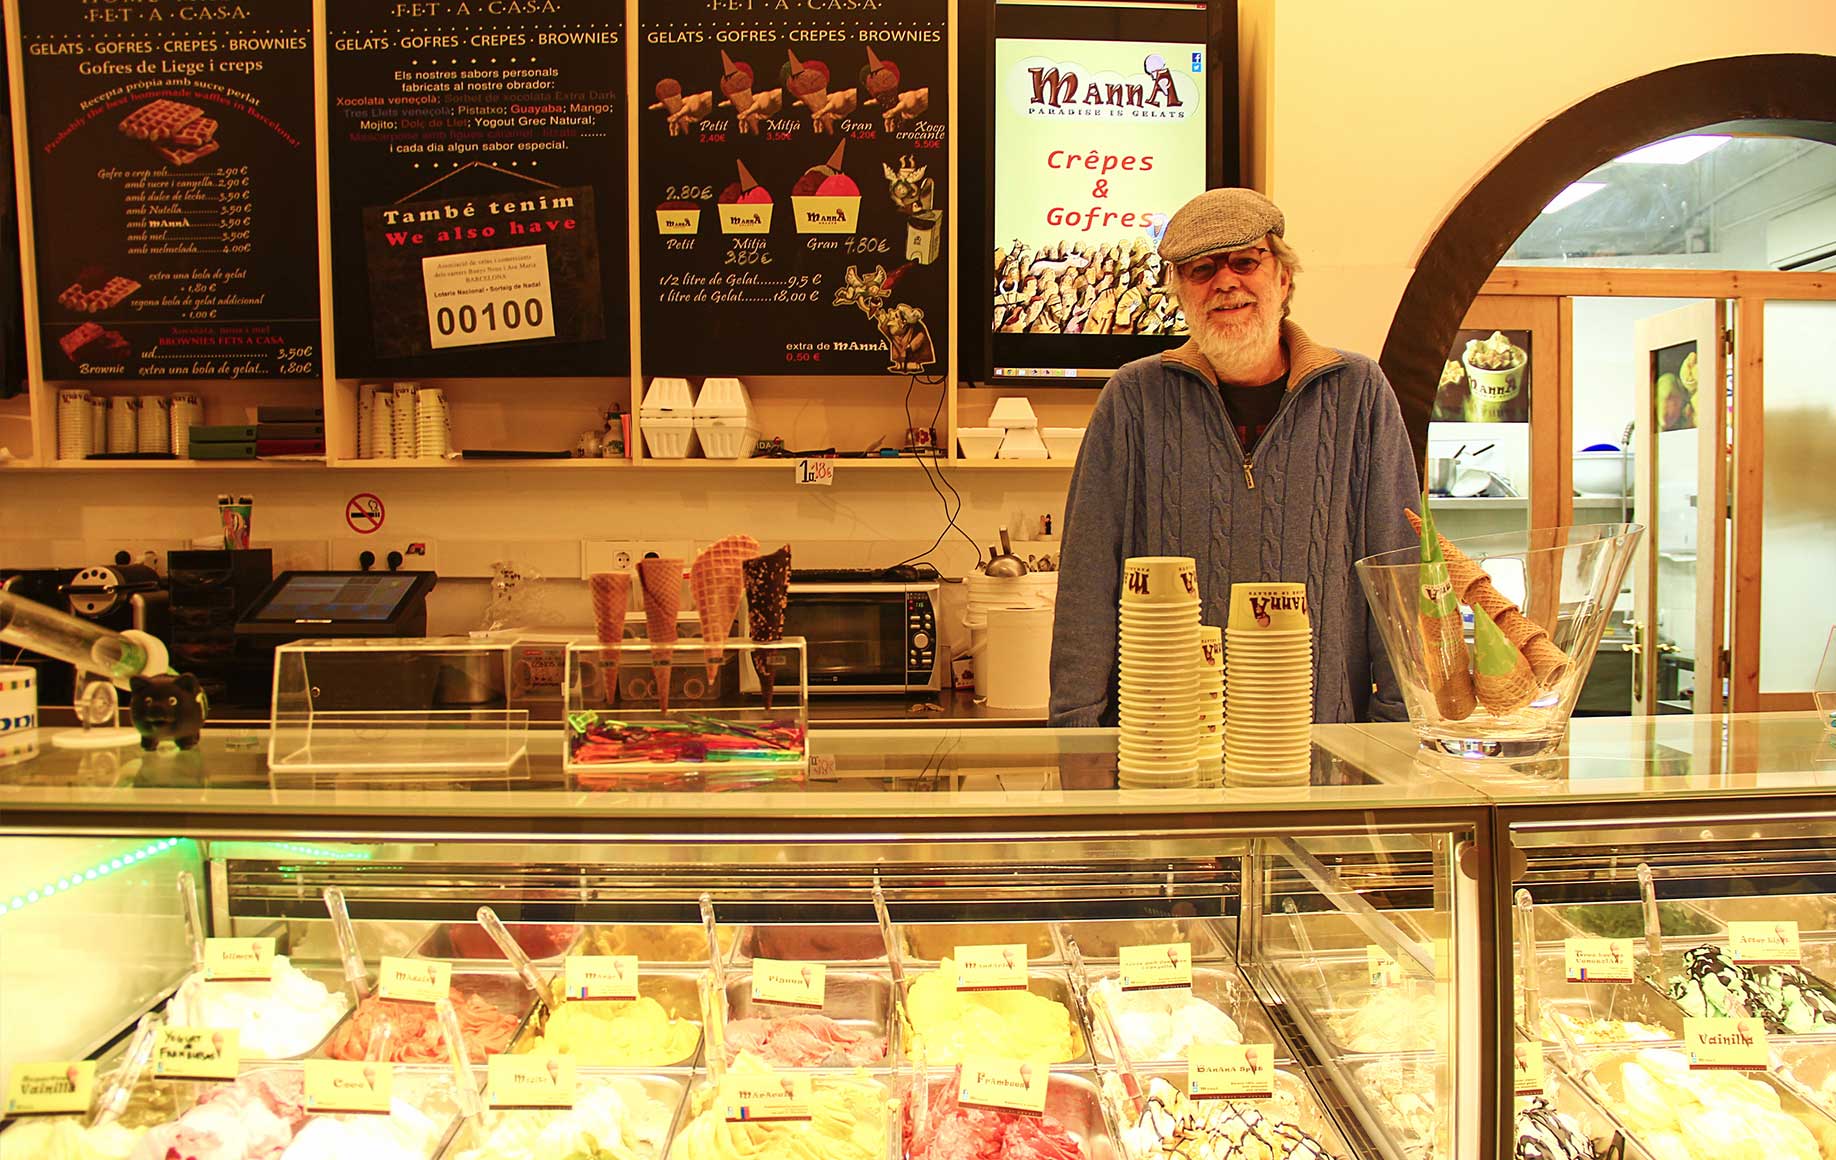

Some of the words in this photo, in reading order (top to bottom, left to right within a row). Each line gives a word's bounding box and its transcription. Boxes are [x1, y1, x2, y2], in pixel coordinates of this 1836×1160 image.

[335, 38, 389, 51] GELATS
[401, 36, 458, 49] GOFRES
[471, 34, 526, 47] CREPES
[539, 32, 618, 46] BROWNIES
[647, 31, 704, 44] GELATS
[716, 30, 776, 42] GOFRES
[789, 29, 846, 42] CREPES
[859, 29, 940, 42] BROWNIES
[29, 42, 84, 55] GELATS
[95, 41, 152, 54] GOFRES
[164, 40, 217, 53] CREPES
[229, 38, 306, 50] BROWNIES
[79, 60, 133, 75] Gofres
[136, 60, 156, 73] de
[161, 60, 204, 76] Liege
[210, 59, 214, 72] i
[219, 60, 263, 74] creps
[395, 71, 413, 81] Els
[415, 71, 457, 80] nostres
[460, 69, 499, 79] sabors
[502, 67, 558, 80] personals
[402, 82, 450, 93] fabricats
[453, 82, 464, 91] al
[467, 81, 503, 90] nostre
[507, 79, 555, 90] obrador:
[79, 87, 124, 111] Recepta
[126, 78, 163, 91] pròpia
[165, 77, 191, 87] amb
[194, 78, 224, 93] sucre
[226, 88, 260, 107] perlat
[336, 96, 384, 107] Xocolata
[458, 105, 507, 116] Pistatxo;
[510, 103, 567, 116] Guayaba;
[570, 103, 613, 115] Mango;
[1029, 108, 1101, 116] PARADISE
[1132, 110, 1185, 118] GELATS
[360, 120, 398, 131] Mojito;
[475, 117, 515, 129] Yogout
[518, 116, 547, 126] Grec
[549, 115, 596, 126] Natural;
[700, 120, 729, 131] Petit
[840, 119, 872, 131] Gran
[915, 121, 945, 132] Xoco
[896, 131, 945, 140] crocante
[396, 143, 424, 153] cada
[426, 142, 445, 152] dia
[447, 141, 479, 154] algun
[482, 141, 515, 151] sabor
[517, 140, 569, 152] especial.
[1047, 150, 1153, 175] Crêpes
[97, 168, 123, 180] Gofre
[125, 180, 145, 189] amb
[1092, 179, 1108, 198] &
[125, 191, 145, 202] amb
[148, 190, 170, 201] dulce
[126, 204, 146, 215] amb
[383, 202, 475, 225] També
[489, 195, 574, 215] tenim
[126, 218, 146, 228] amb
[1046, 207, 1153, 232] Gofres
[127, 230, 147, 241] amb
[385, 231, 424, 247] We
[437, 225, 496, 242] also
[509, 218, 576, 235] have
[128, 243, 148, 255] amb
[666, 239, 697, 250] Petit
[807, 238, 838, 249] Gran
[148, 271, 171, 281] extra
[191, 268, 211, 279] bola
[213, 267, 223, 279] de
[224, 268, 247, 284] gelat
[659, 274, 679, 286] 1/2
[682, 273, 706, 285] litre
[709, 273, 723, 285] de
[457, 287, 485, 296] Nacional
[489, 285, 513, 294] Sorteig
[523, 281, 541, 289] Nadal
[162, 296, 181, 305] bola
[182, 296, 192, 305] de
[194, 296, 217, 311] gelat
[218, 293, 265, 305] addicional
[667, 291, 691, 303] litre
[693, 291, 707, 303] de
[436, 298, 543, 336] 00100
[159, 336, 215, 345] BROWNIES
[217, 336, 243, 345] FETS
[246, 336, 253, 344] A
[255, 335, 284, 344] CASA
[786, 342, 814, 351] extra
[817, 341, 831, 351] de
[79, 364, 125, 375] Brownie
[138, 364, 165, 377] extra
[168, 366, 189, 374] una
[192, 363, 215, 374] bola
[218, 362, 230, 374] de
[1699, 1033, 1753, 1047] Vainilla
[21, 1082, 76, 1094] Vainilla
